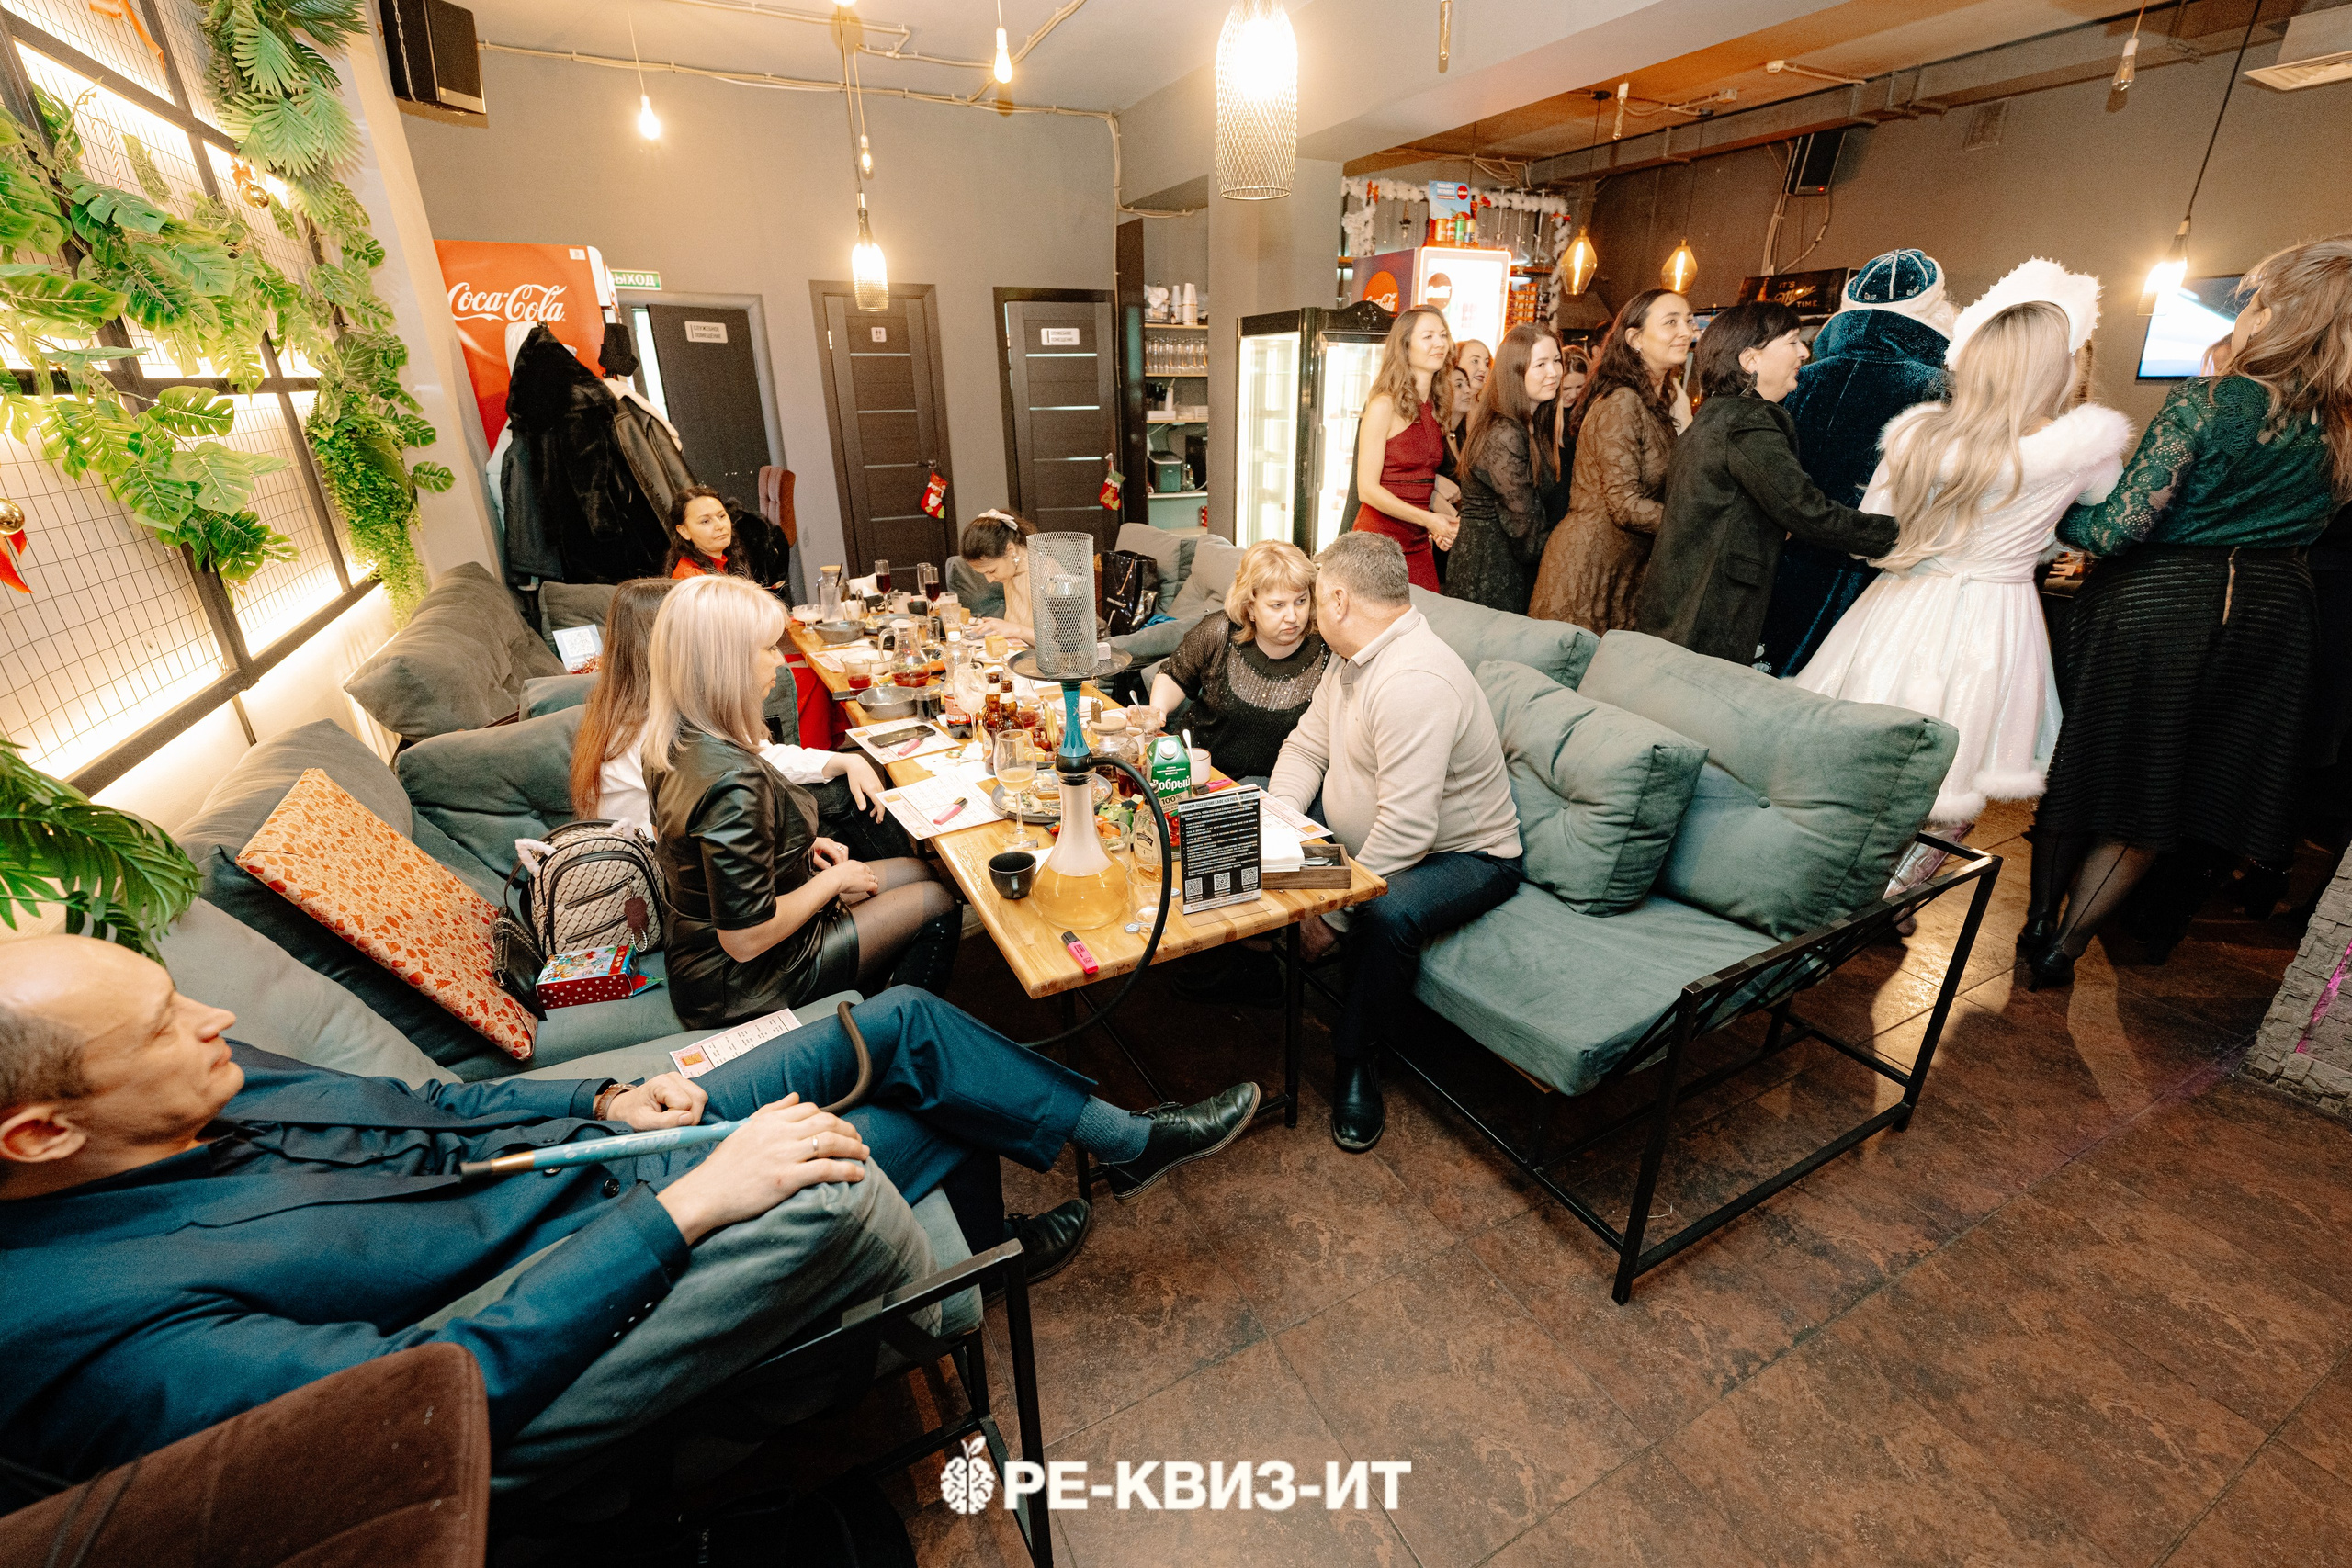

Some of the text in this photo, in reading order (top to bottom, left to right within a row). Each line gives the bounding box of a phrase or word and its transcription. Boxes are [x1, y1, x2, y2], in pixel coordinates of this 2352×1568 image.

[614, 273, 656, 287] ЫХОД
[447, 282, 567, 321] Coca-Cola
[1774, 285, 1816, 306] Mler
[1161, 794, 1183, 805] 100%
